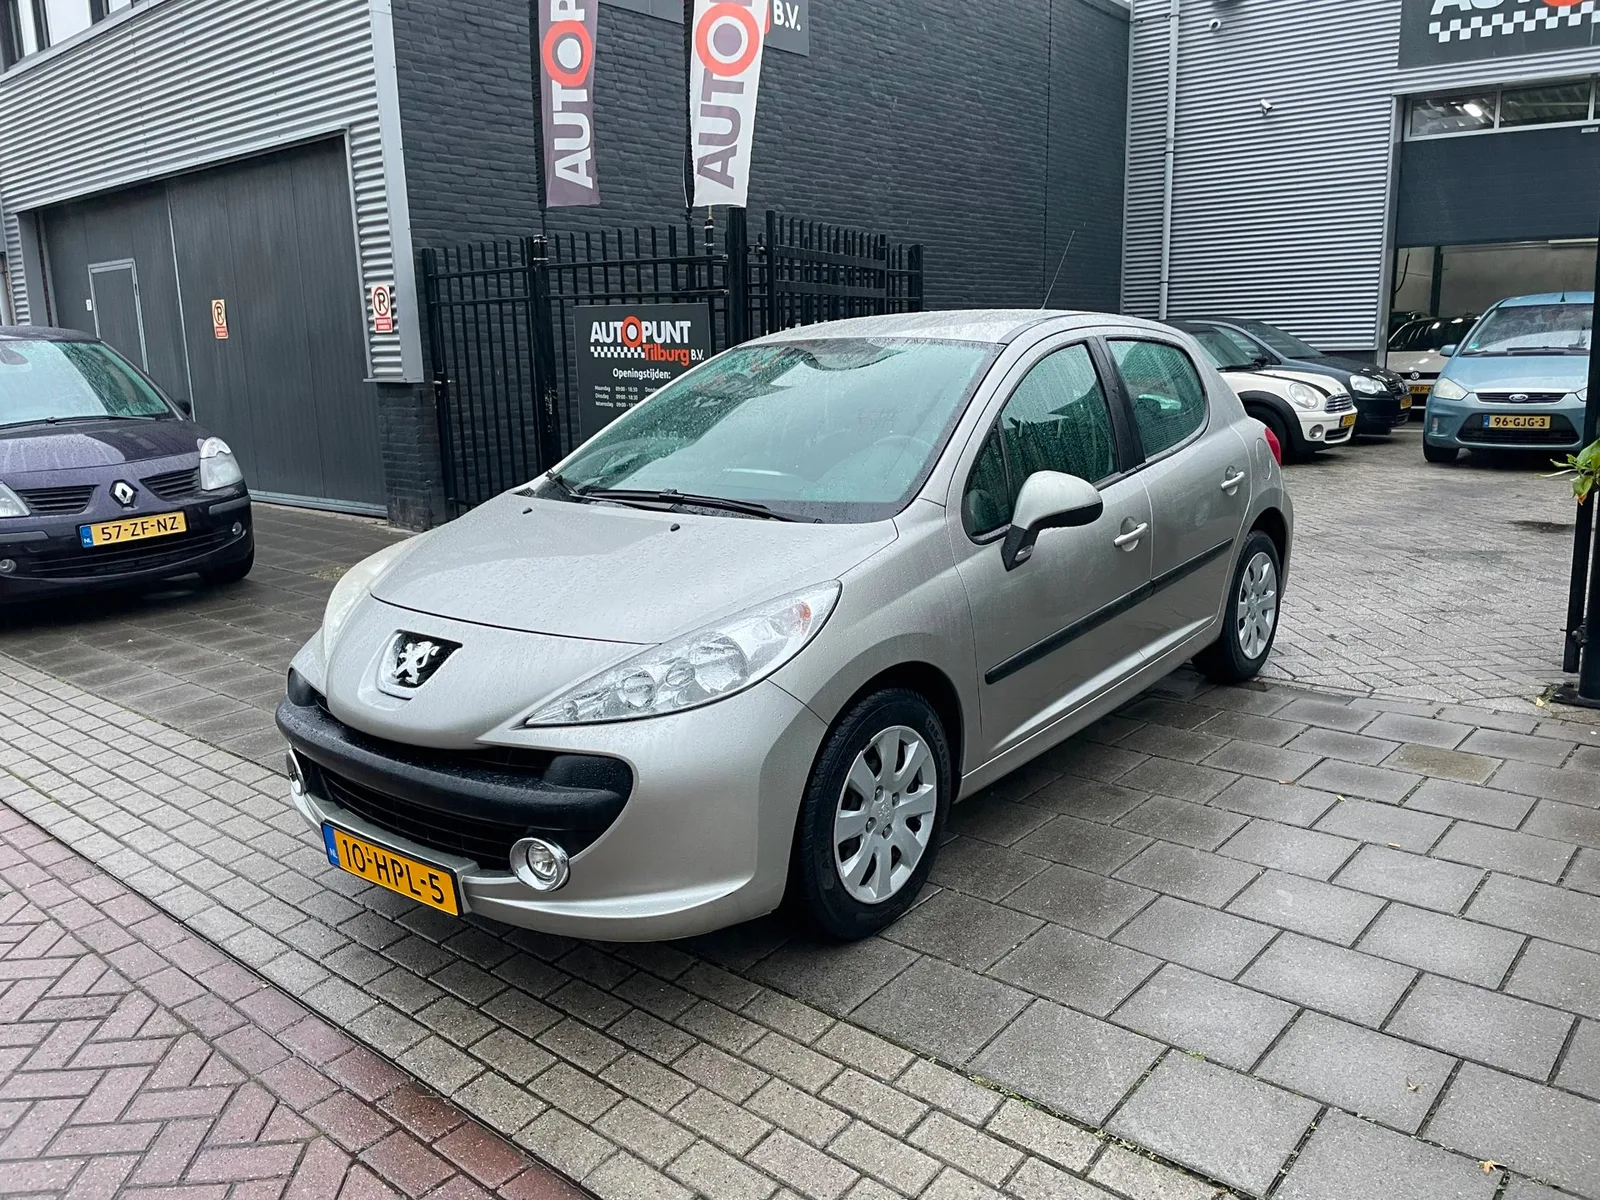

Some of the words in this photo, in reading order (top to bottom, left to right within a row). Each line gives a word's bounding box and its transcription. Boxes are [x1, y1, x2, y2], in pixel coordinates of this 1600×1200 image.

[773, 0, 801, 31] B.V.
[695, 0, 760, 190] AUTO
[590, 316, 692, 348] AUTOPUNT
[642, 343, 690, 366] Tilburg
[690, 349, 705, 361] B.V.
[612, 367, 671, 381] Openingstijden:
[1494, 416, 1546, 427] 96-GJG-3
[101, 516, 179, 541] 57-ZF-NZ
[342, 839, 445, 904] 10-HPL-5
